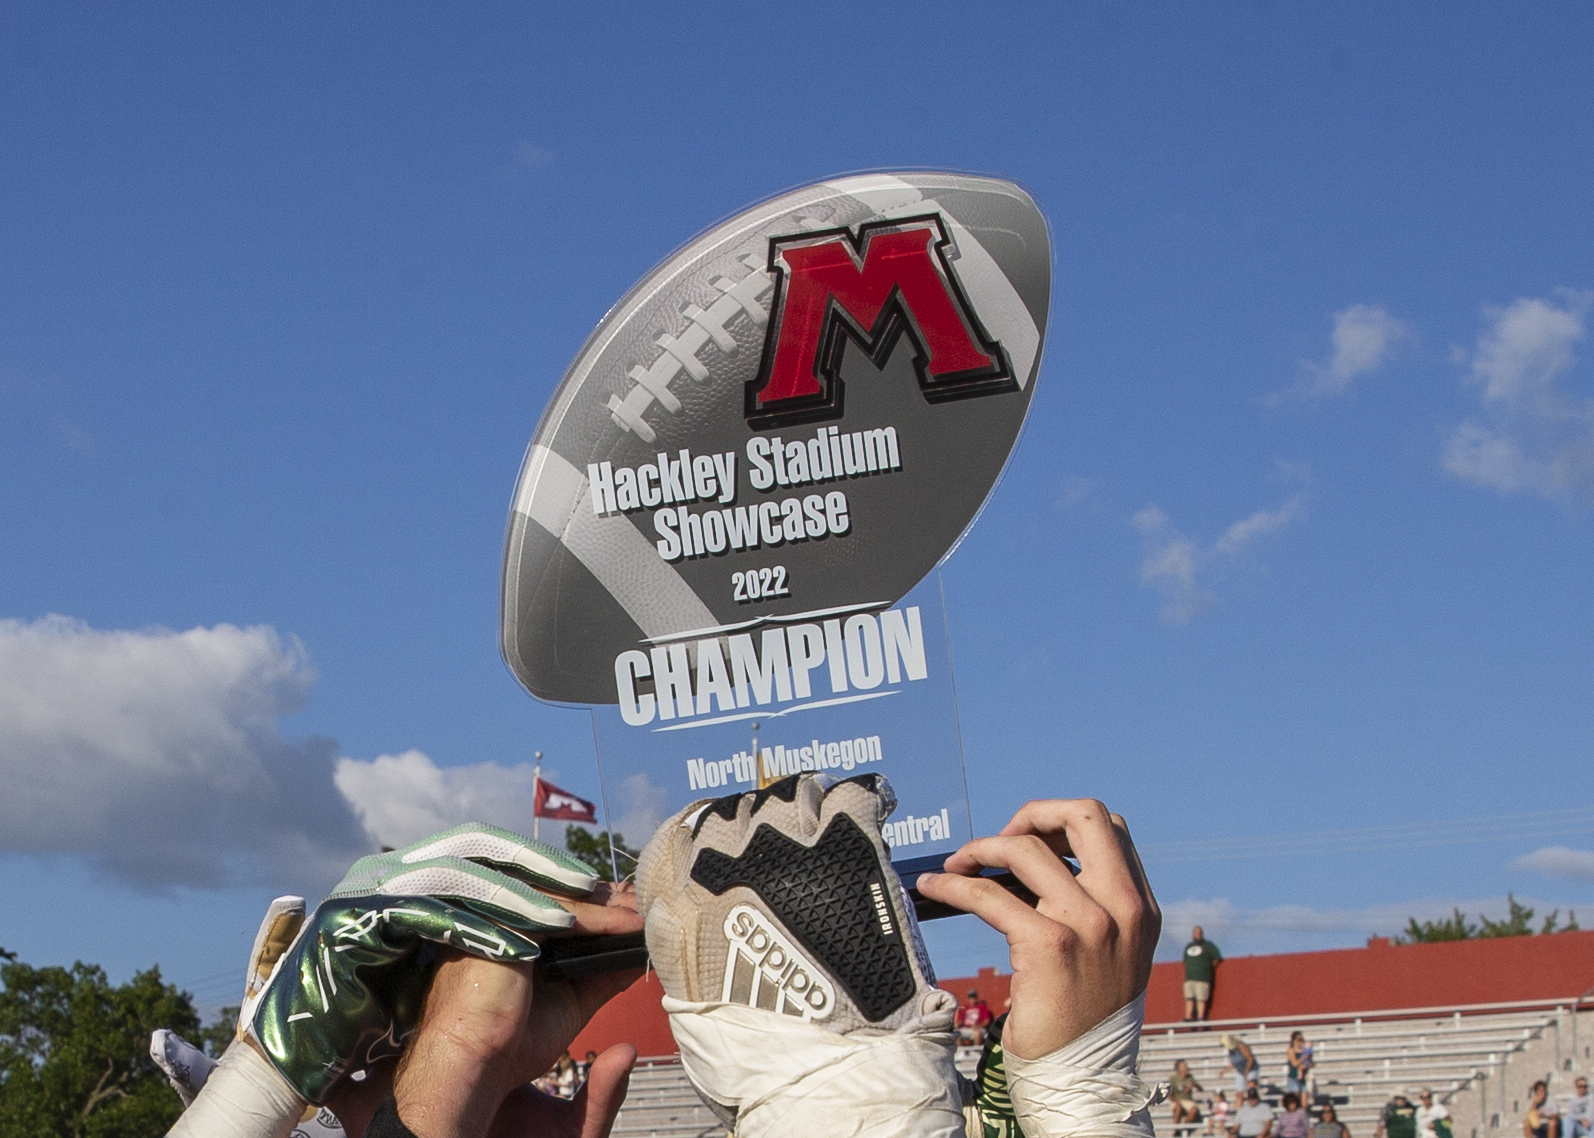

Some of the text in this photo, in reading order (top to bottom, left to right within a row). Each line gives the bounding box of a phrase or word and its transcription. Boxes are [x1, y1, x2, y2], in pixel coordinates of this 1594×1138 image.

[744, 212, 1018, 428] M
[587, 426, 901, 514] Hackley Stadium
[654, 491, 850, 560] Showcase
[731, 565, 789, 602] 2022
[614, 606, 928, 726] CHAMPION
[687, 735, 883, 790] North Muskegon
[882, 808, 951, 848] entral
[870, 882, 894, 935] IRONSKIN
[731, 911, 828, 1011] adidas
